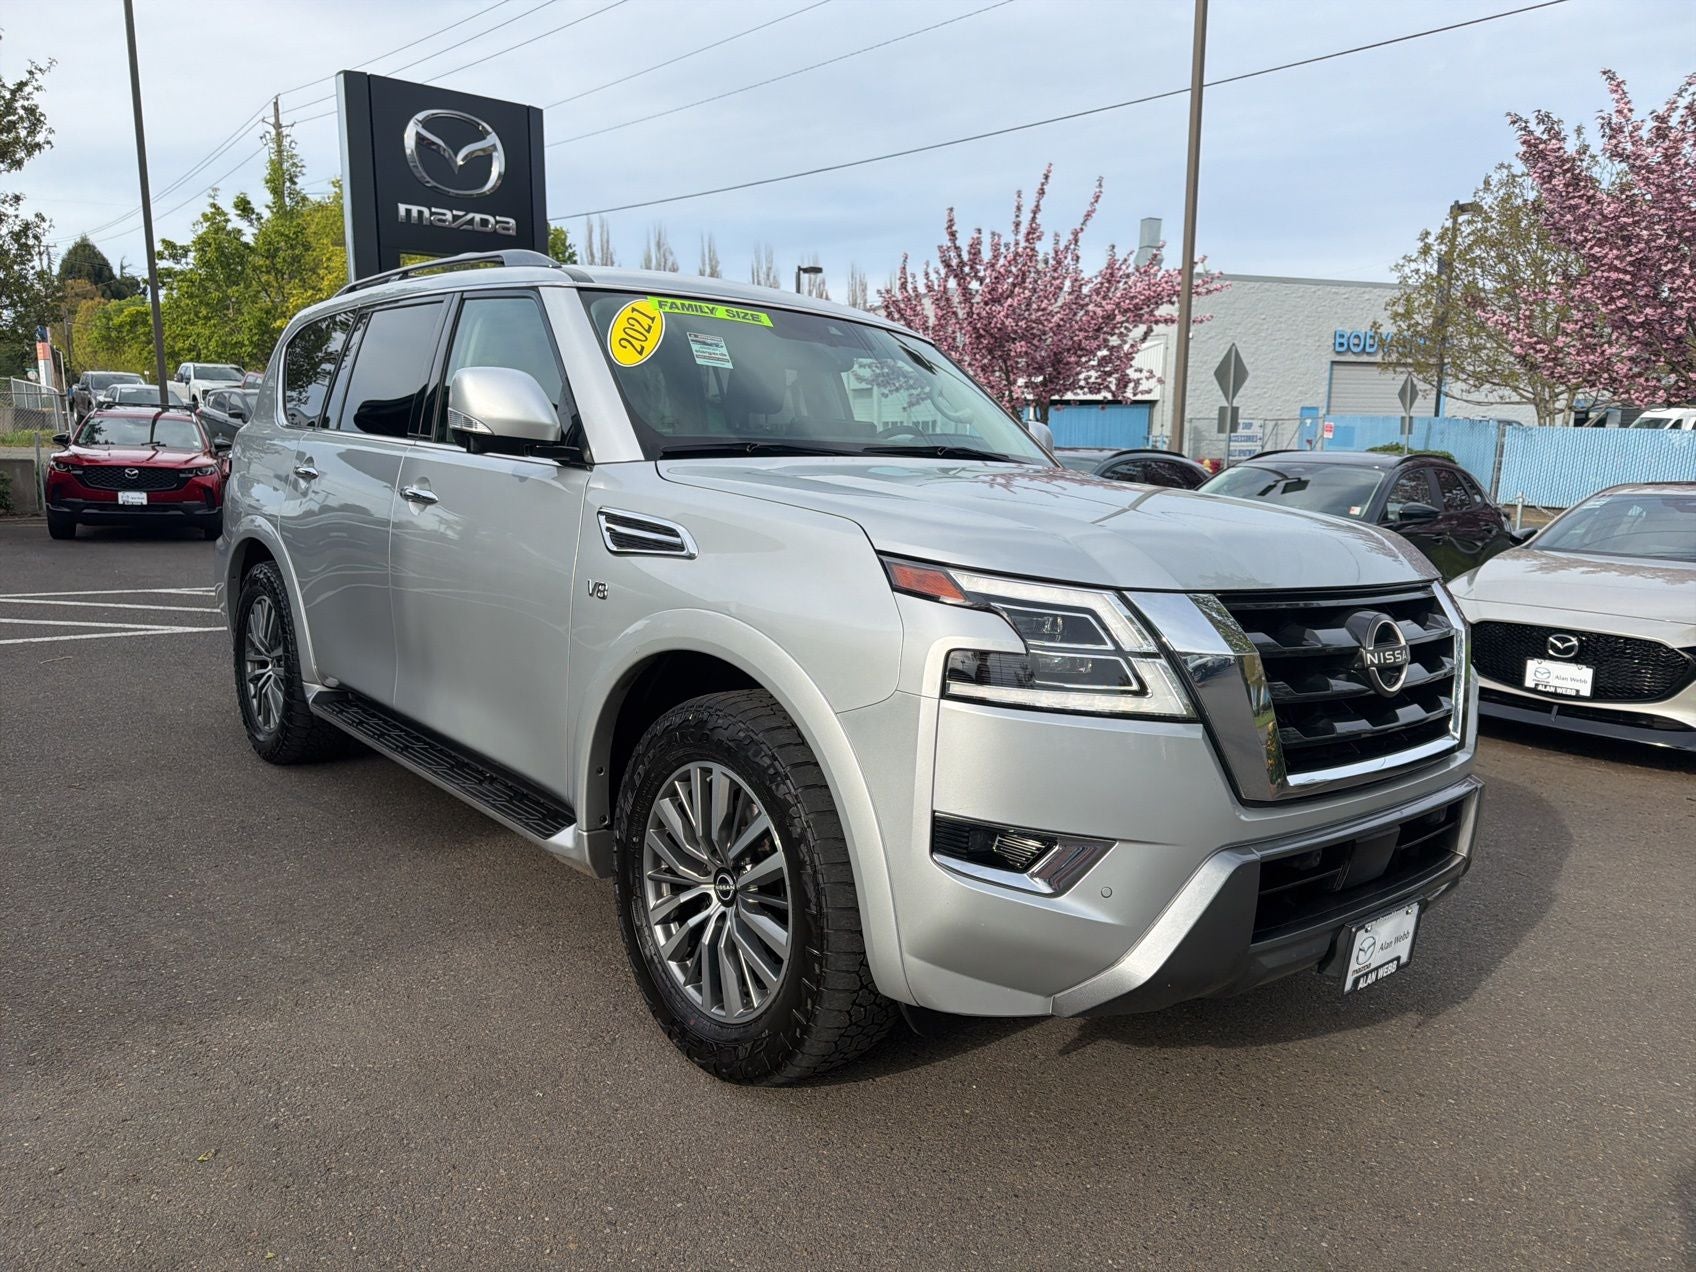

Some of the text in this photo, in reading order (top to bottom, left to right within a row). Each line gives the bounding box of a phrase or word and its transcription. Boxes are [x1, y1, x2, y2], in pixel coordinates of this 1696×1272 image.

[397, 202, 517, 236] mazda
[657, 299, 762, 322] FAMILY SIZE
[618, 306, 657, 357] 2021
[587, 579, 609, 600] V8
[1366, 649, 1407, 665] NISSA
[1537, 684, 1556, 693] ALAN
[1379, 930, 1410, 951] Alan Webb
[1357, 970, 1378, 990] ALAN
